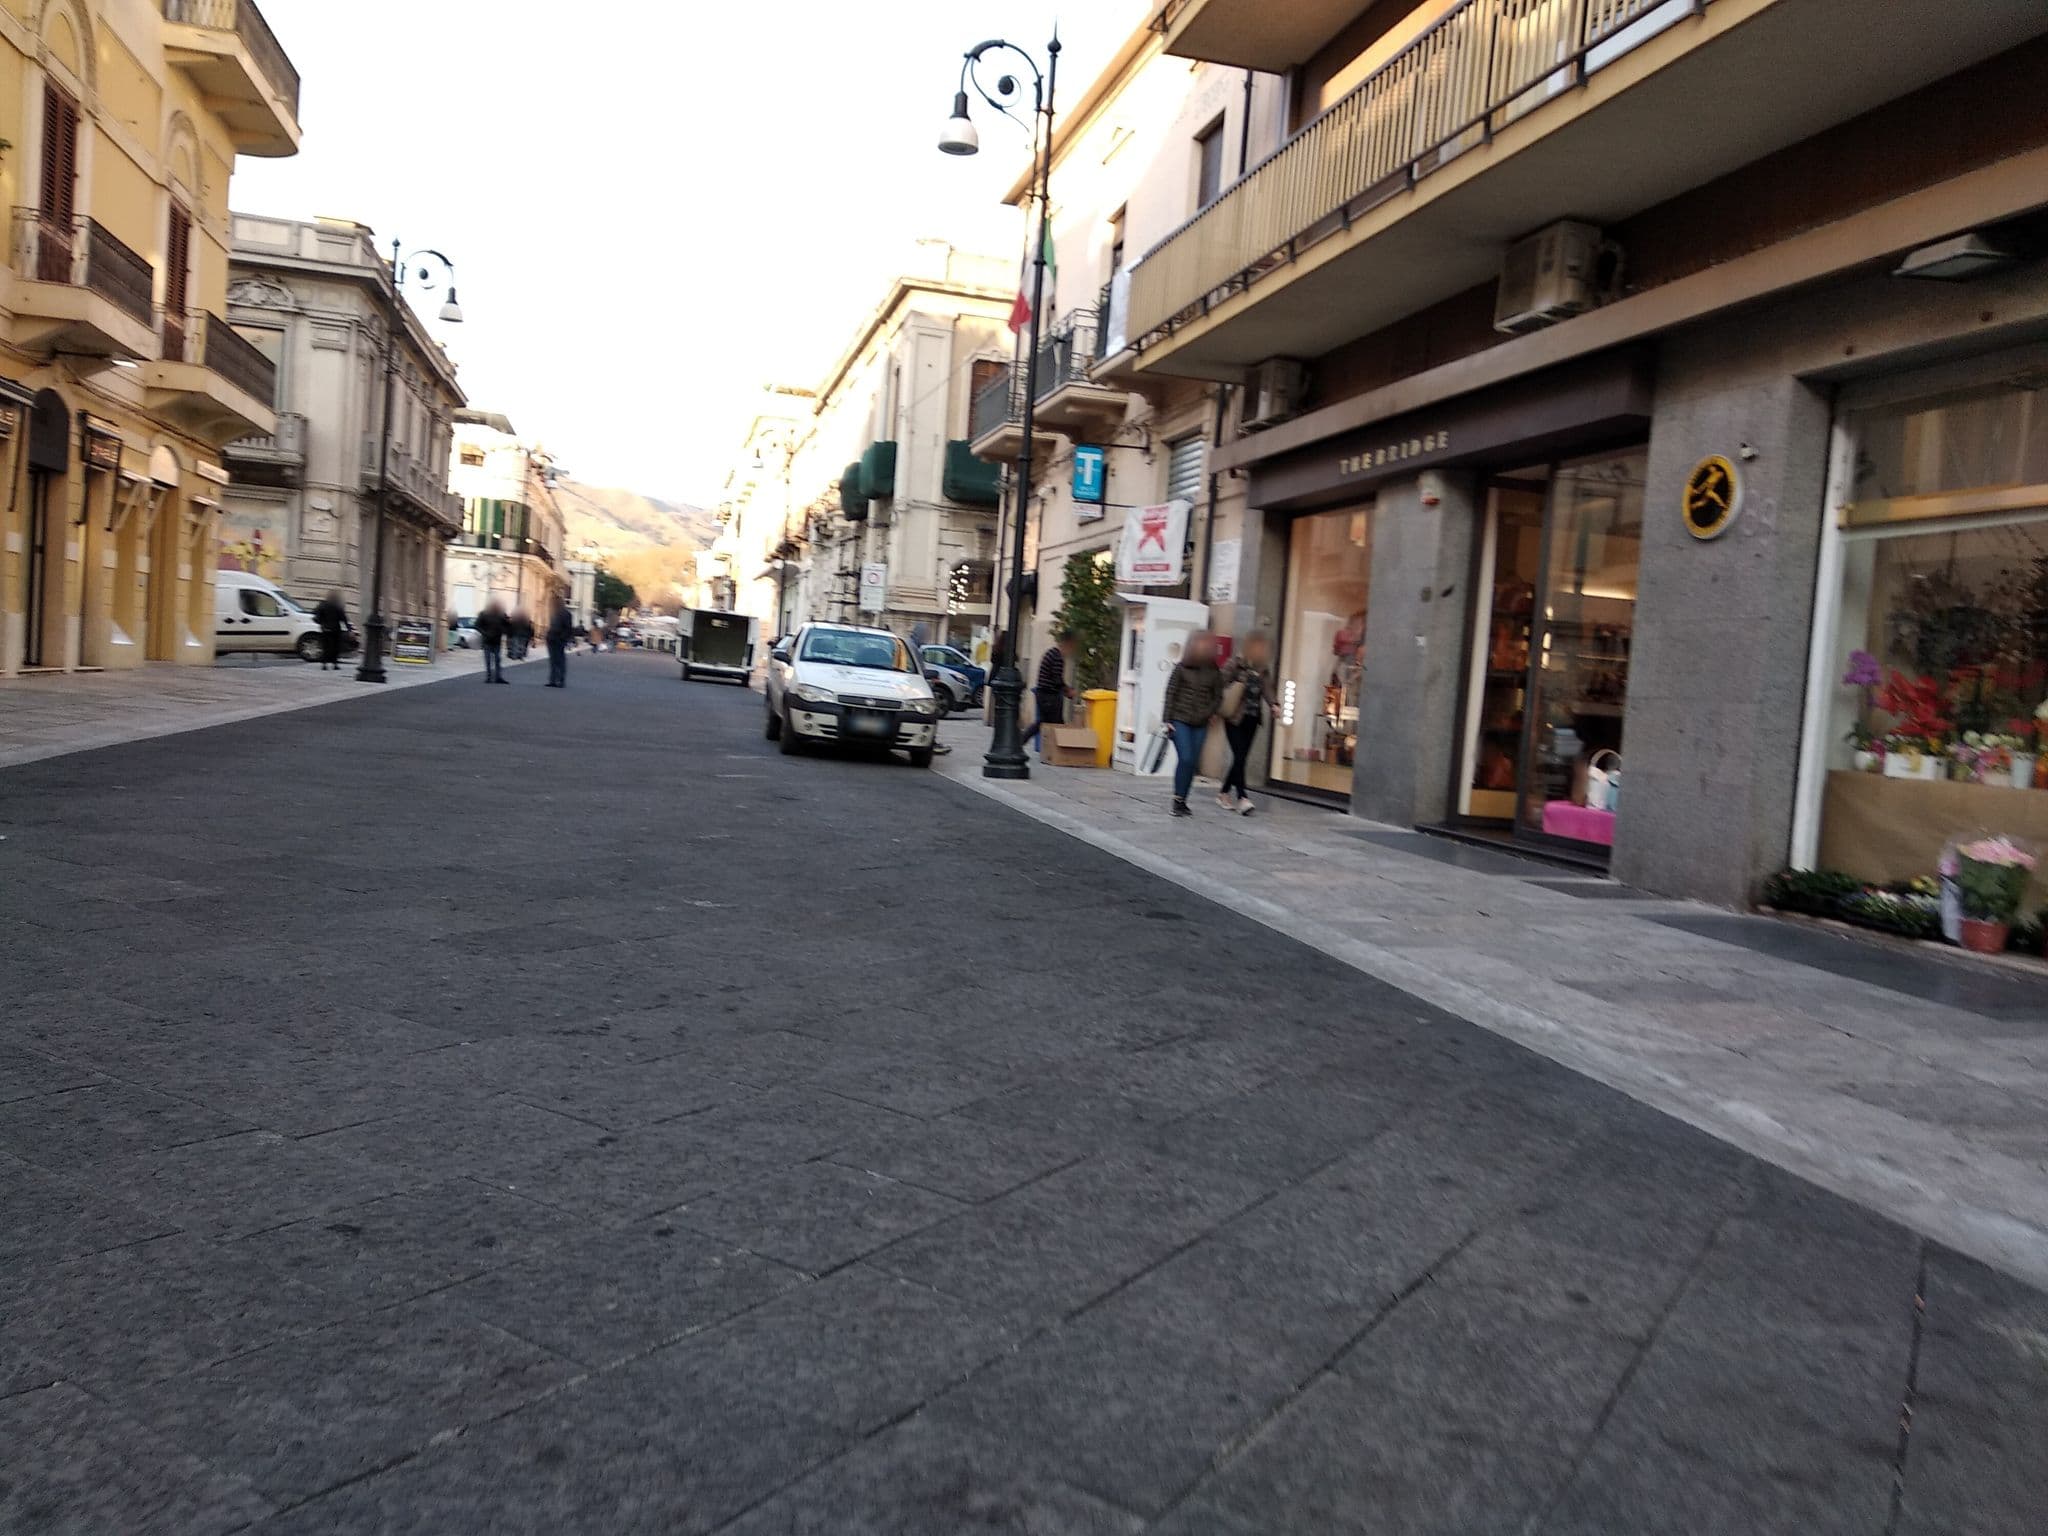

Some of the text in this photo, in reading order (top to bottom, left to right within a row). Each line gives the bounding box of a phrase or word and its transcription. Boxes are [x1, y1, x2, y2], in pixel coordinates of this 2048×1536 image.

[1076, 452, 1103, 485] T
[1339, 430, 1449, 475] THE BRIDGE
